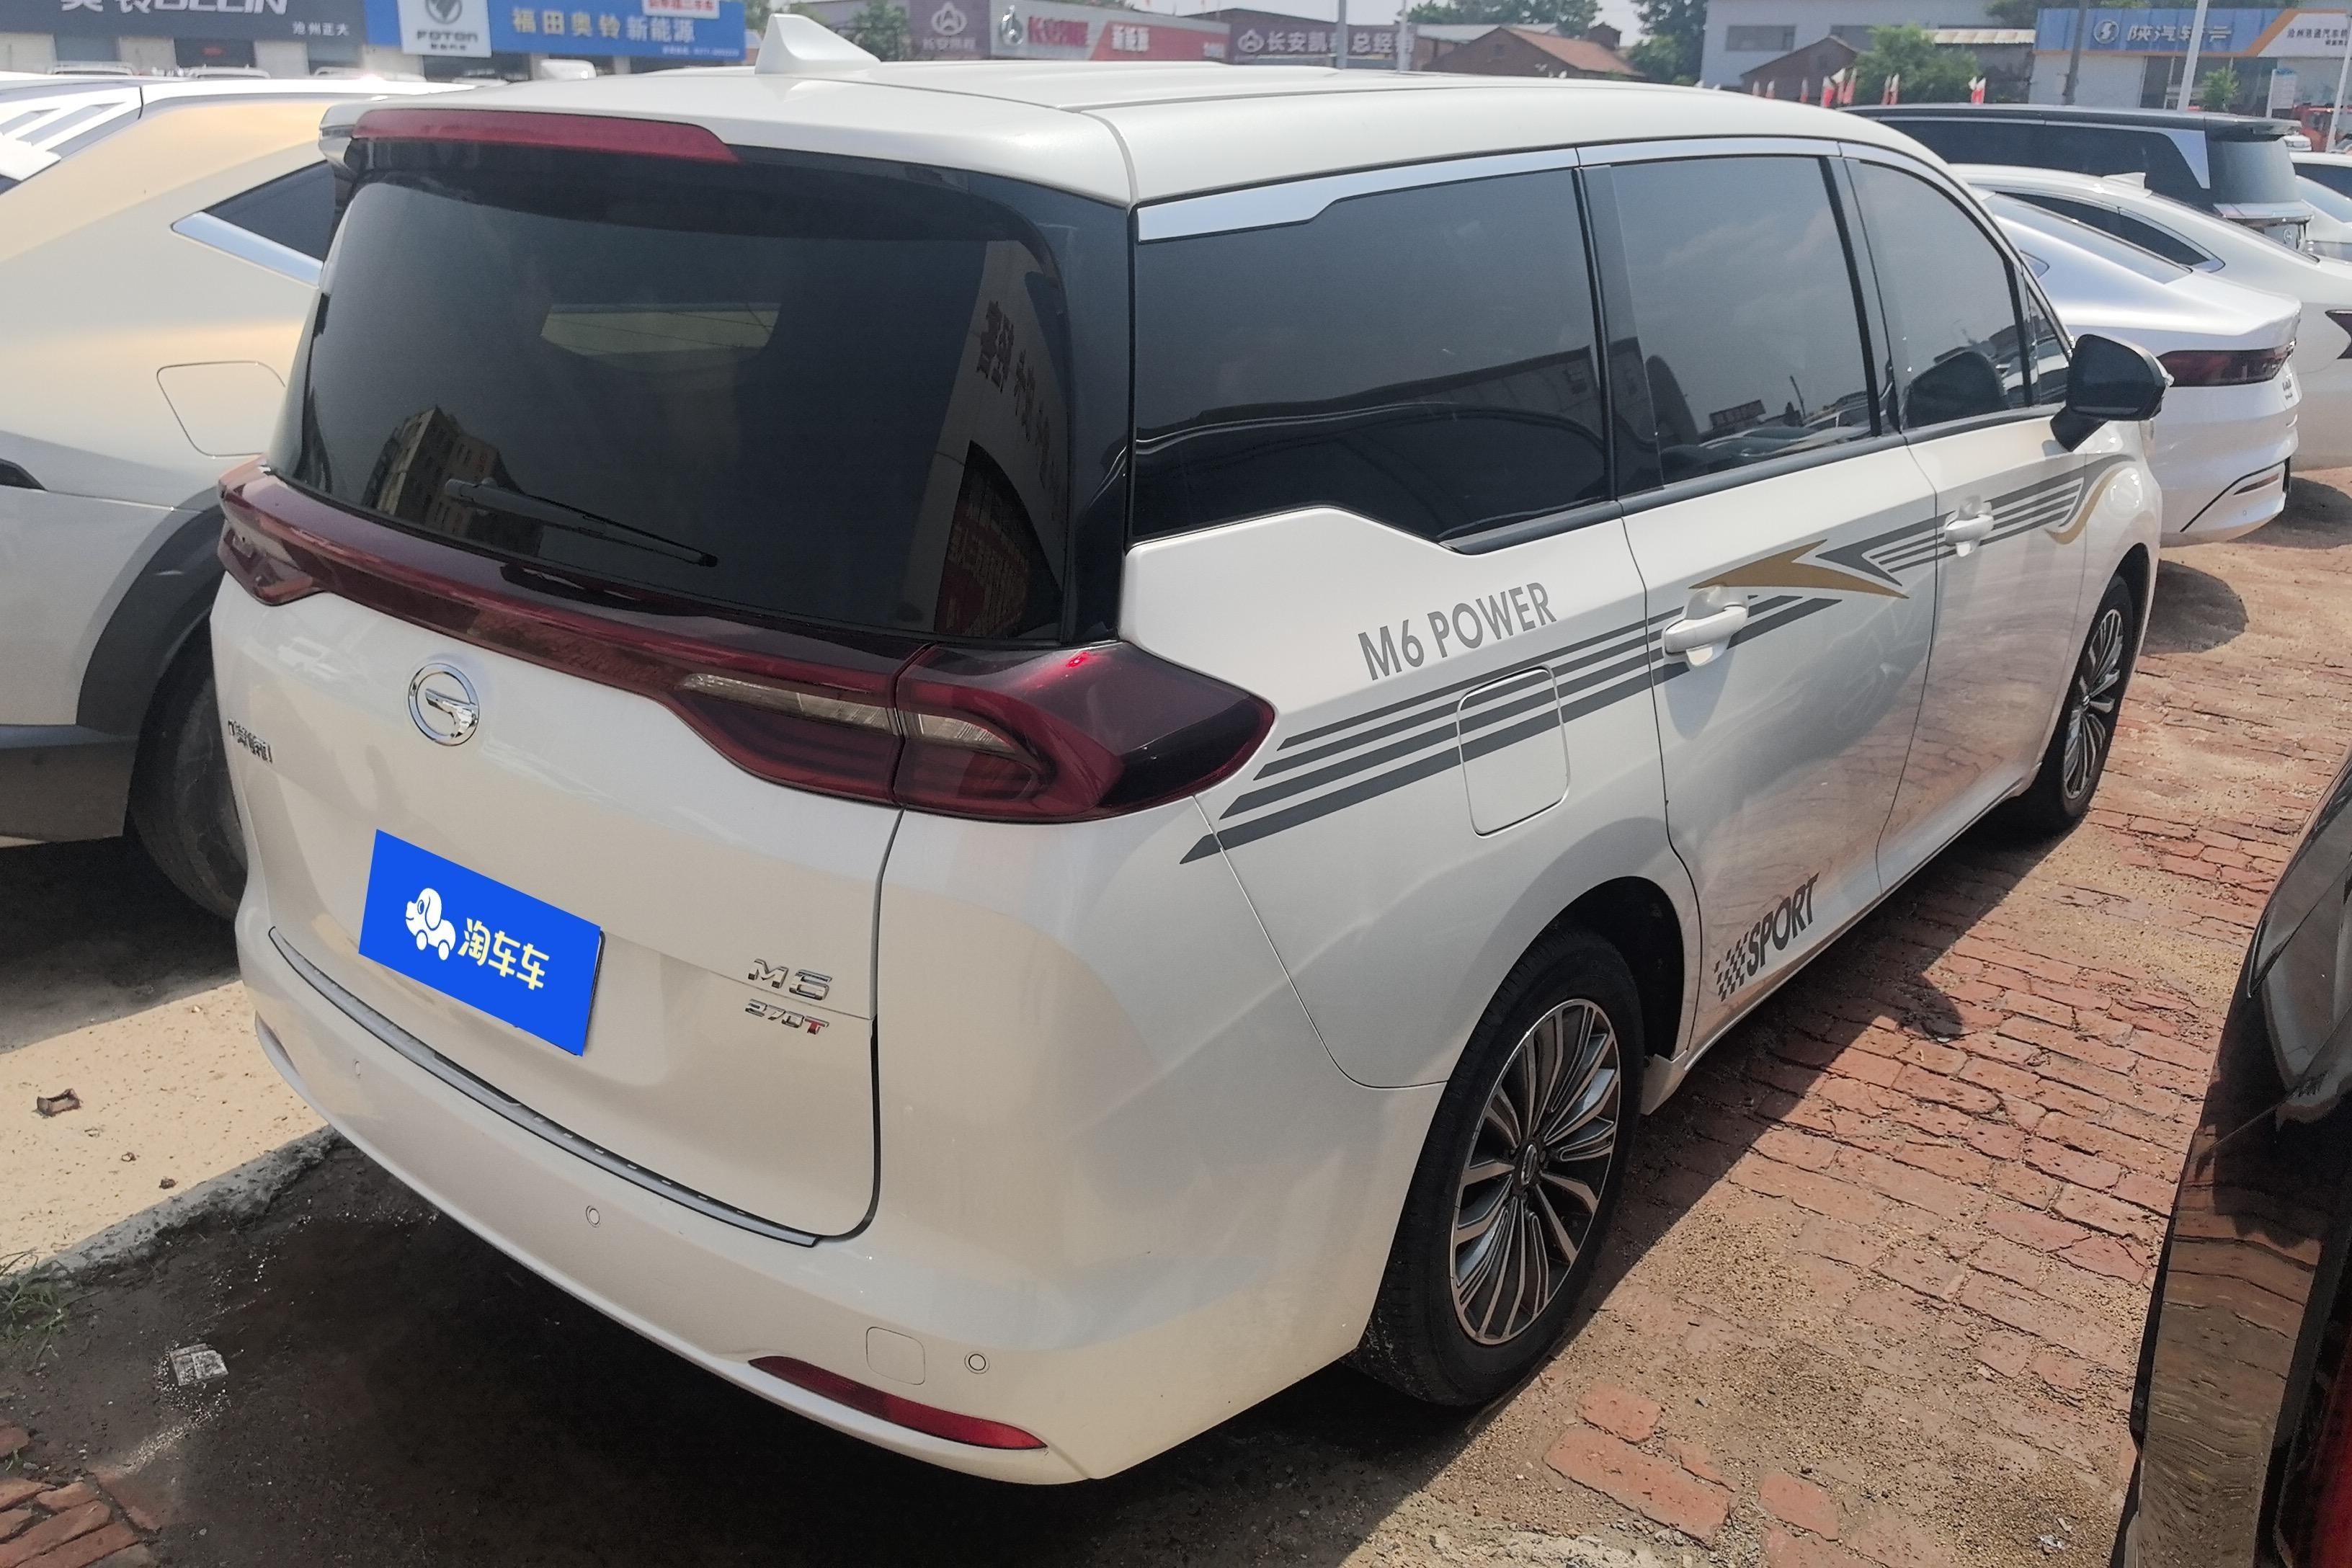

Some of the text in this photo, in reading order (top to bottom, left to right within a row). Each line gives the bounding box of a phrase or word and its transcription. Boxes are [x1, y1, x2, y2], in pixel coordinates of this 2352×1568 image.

[512, 7, 695, 43] 福田奥铃新能源
[1358, 582, 1557, 681] M6 POWER
[1747, 871, 1820, 977] SPORT
[747, 958, 833, 1001] M6
[744, 998, 830, 1035] 270T
